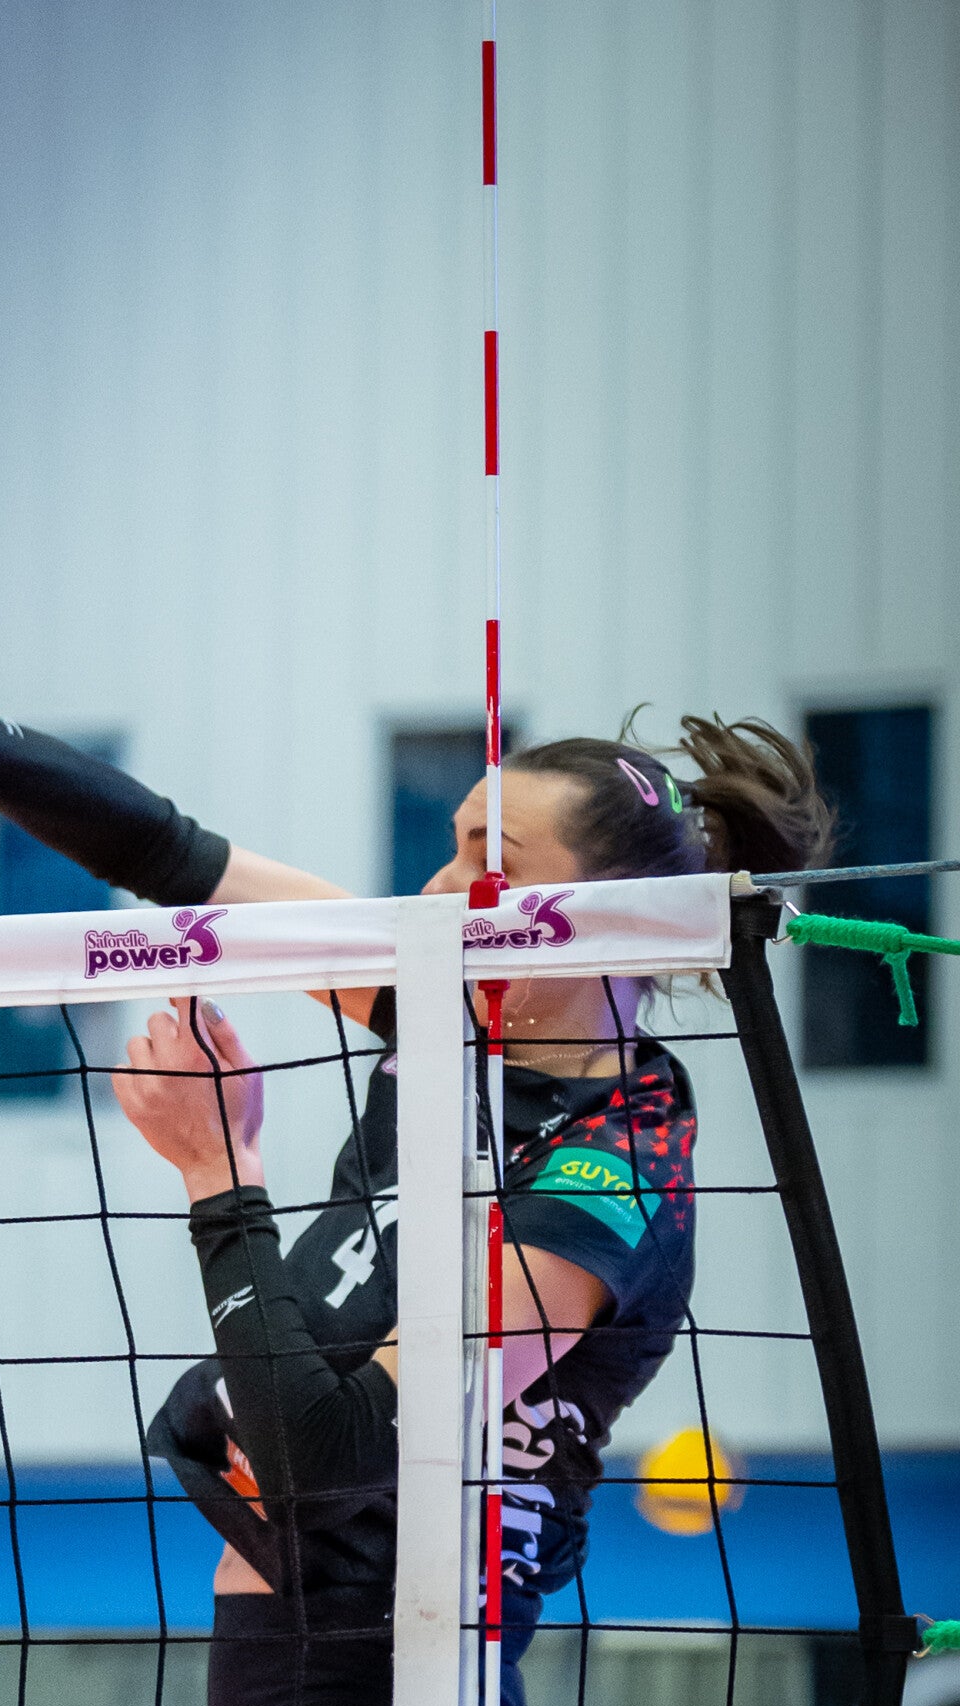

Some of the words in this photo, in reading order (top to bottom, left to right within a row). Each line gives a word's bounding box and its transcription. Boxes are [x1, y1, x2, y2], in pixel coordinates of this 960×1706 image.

[464, 920, 493, 938] relle
[87, 932, 146, 949] Saforelle
[87, 946, 191, 976] power
